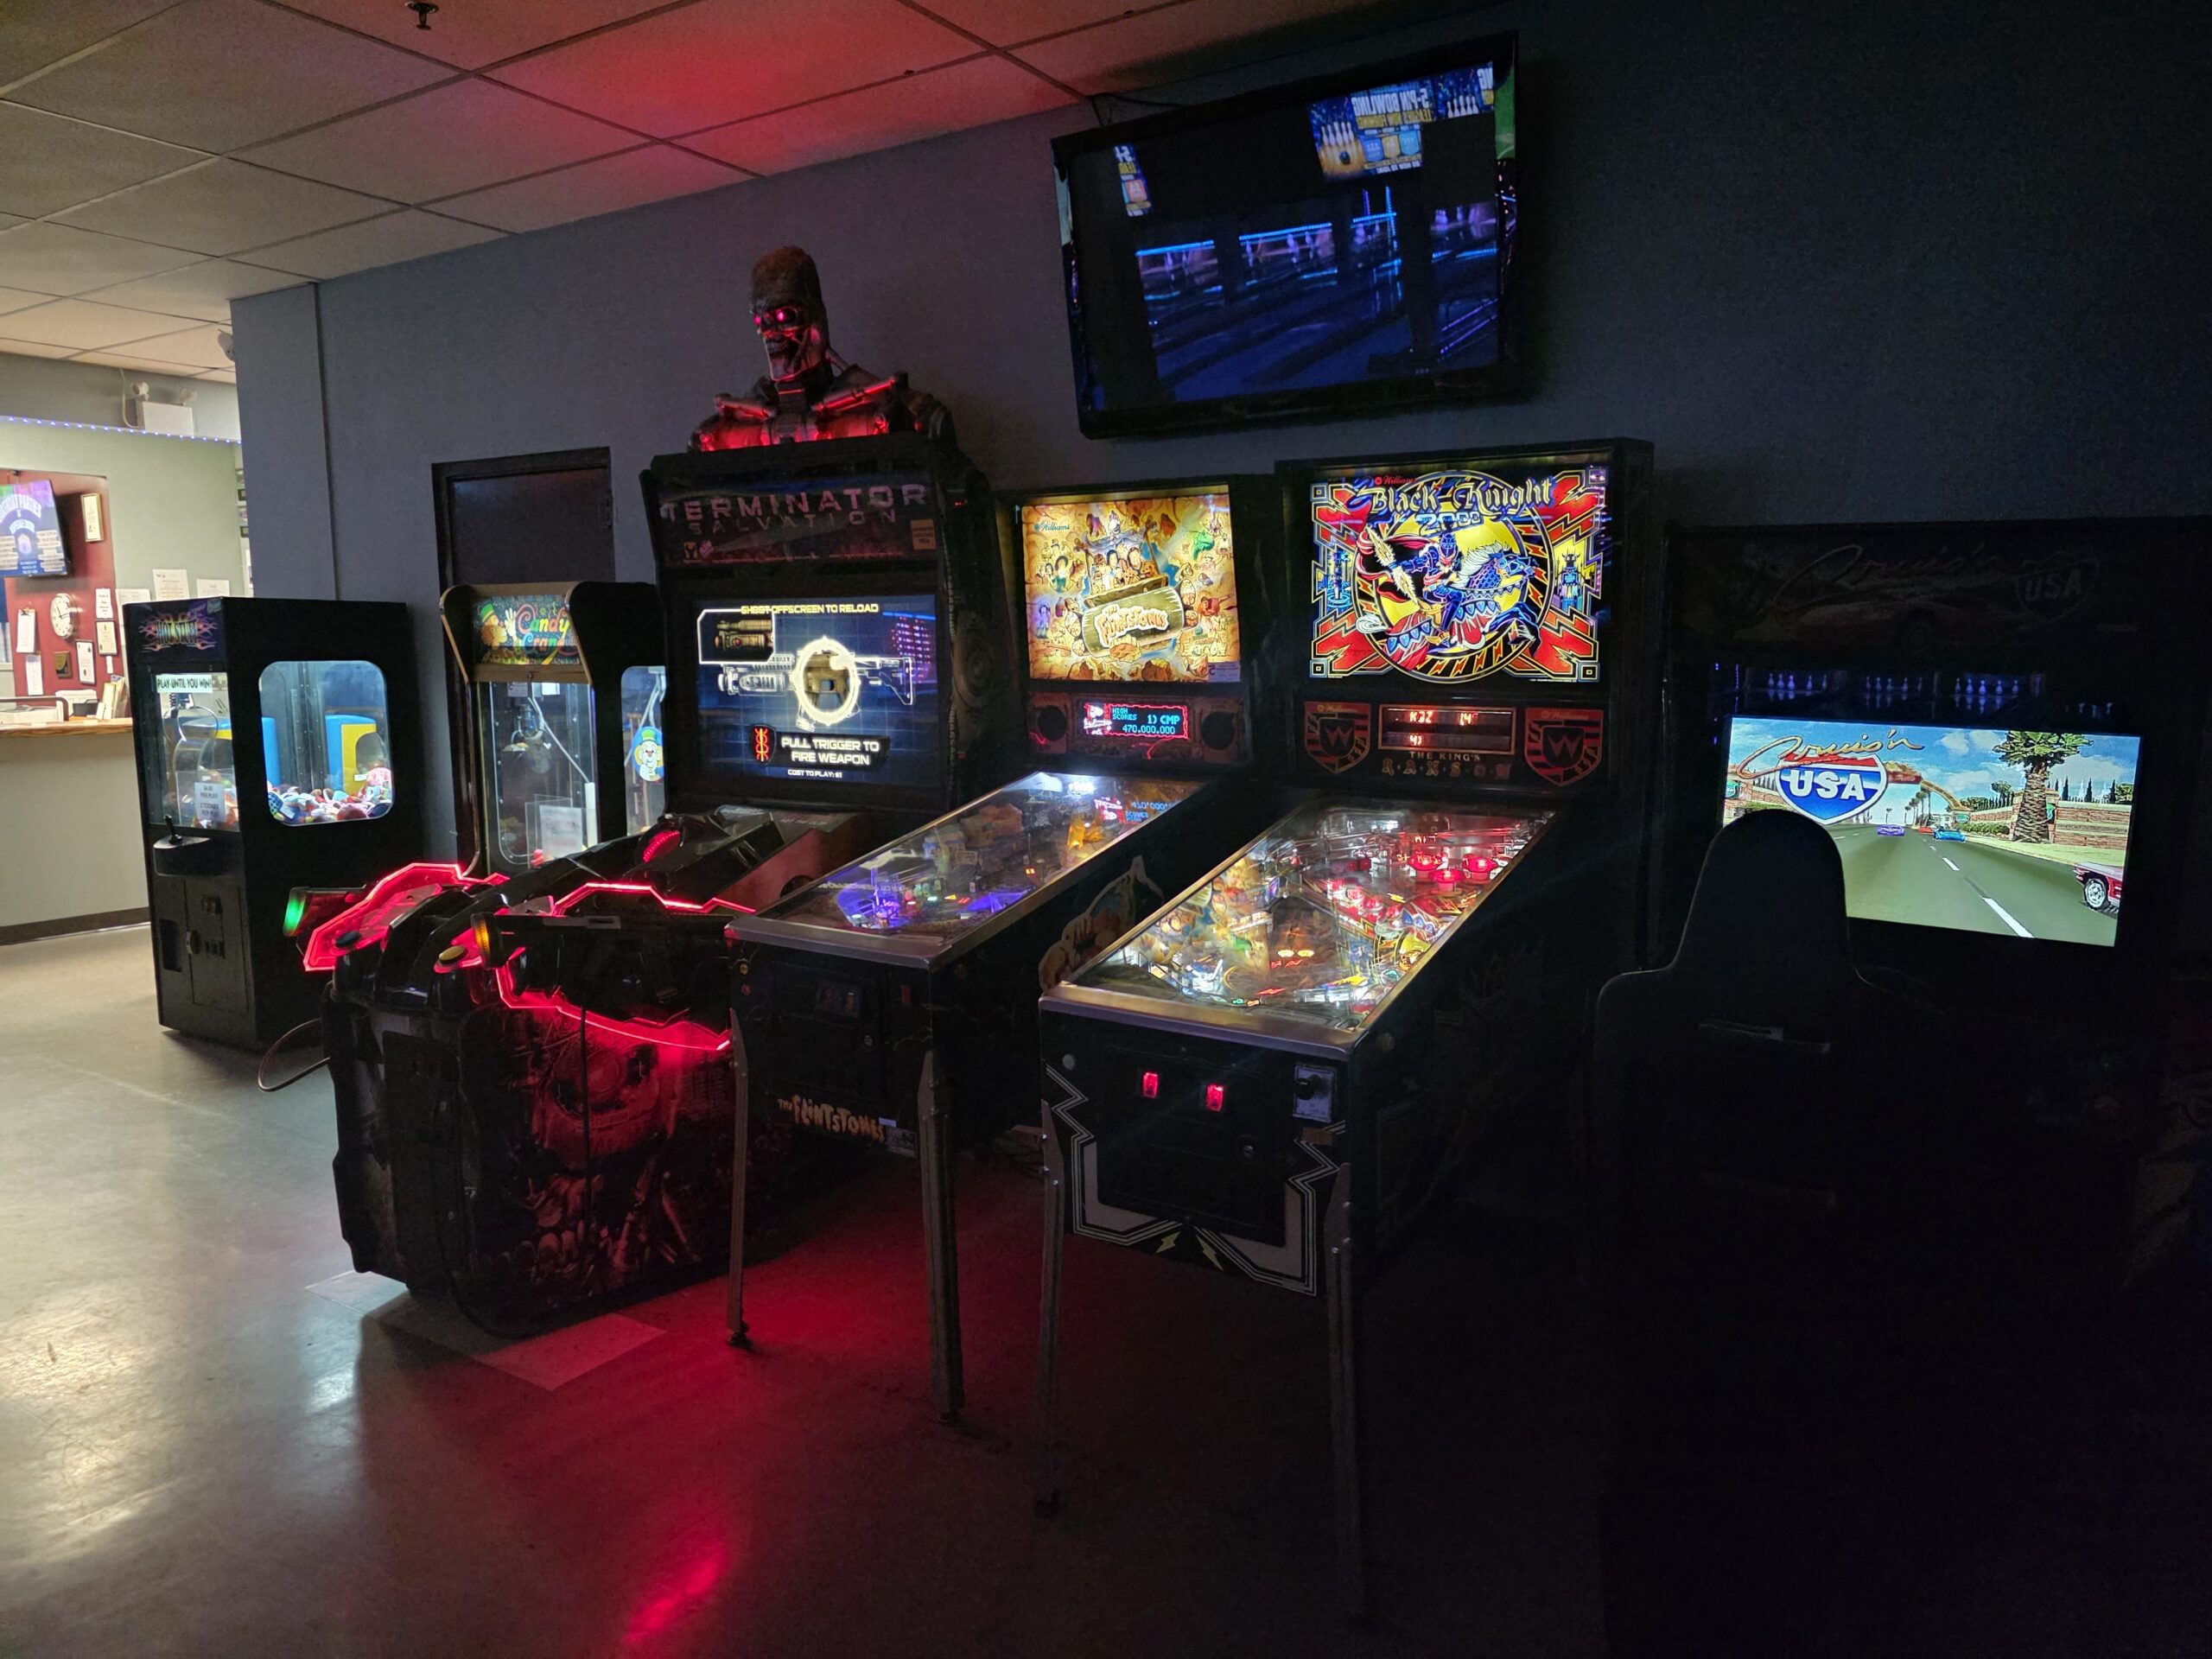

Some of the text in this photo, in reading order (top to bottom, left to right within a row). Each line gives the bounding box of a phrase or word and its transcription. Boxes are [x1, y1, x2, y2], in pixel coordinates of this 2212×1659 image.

[658, 482, 927, 523] TERMINATOR
[1357, 476, 1554, 517] Black Knight
[688, 508, 897, 537] SALVATION
[1039, 522, 1071, 531] Williams
[1414, 511, 1484, 537] 2000
[771, 605, 823, 614] OFFSCREEN
[825, 604, 838, 613] TO
[839, 603, 879, 613] RELOAD
[516, 603, 570, 639] Candy
[157, 679, 170, 689] PLAY
[171, 678, 187, 689] UNTIL
[187, 678, 198, 689] YOU
[1160, 715, 1180, 725] CMP
[781, 737, 880, 753] PULL TRIGGER TO
[1736, 728, 1925, 779] Cruis'n
[791, 752, 870, 766] FIRE WEAPON
[1409, 752, 1481, 762] THE KING'S
[1789, 768, 1866, 802] USA
